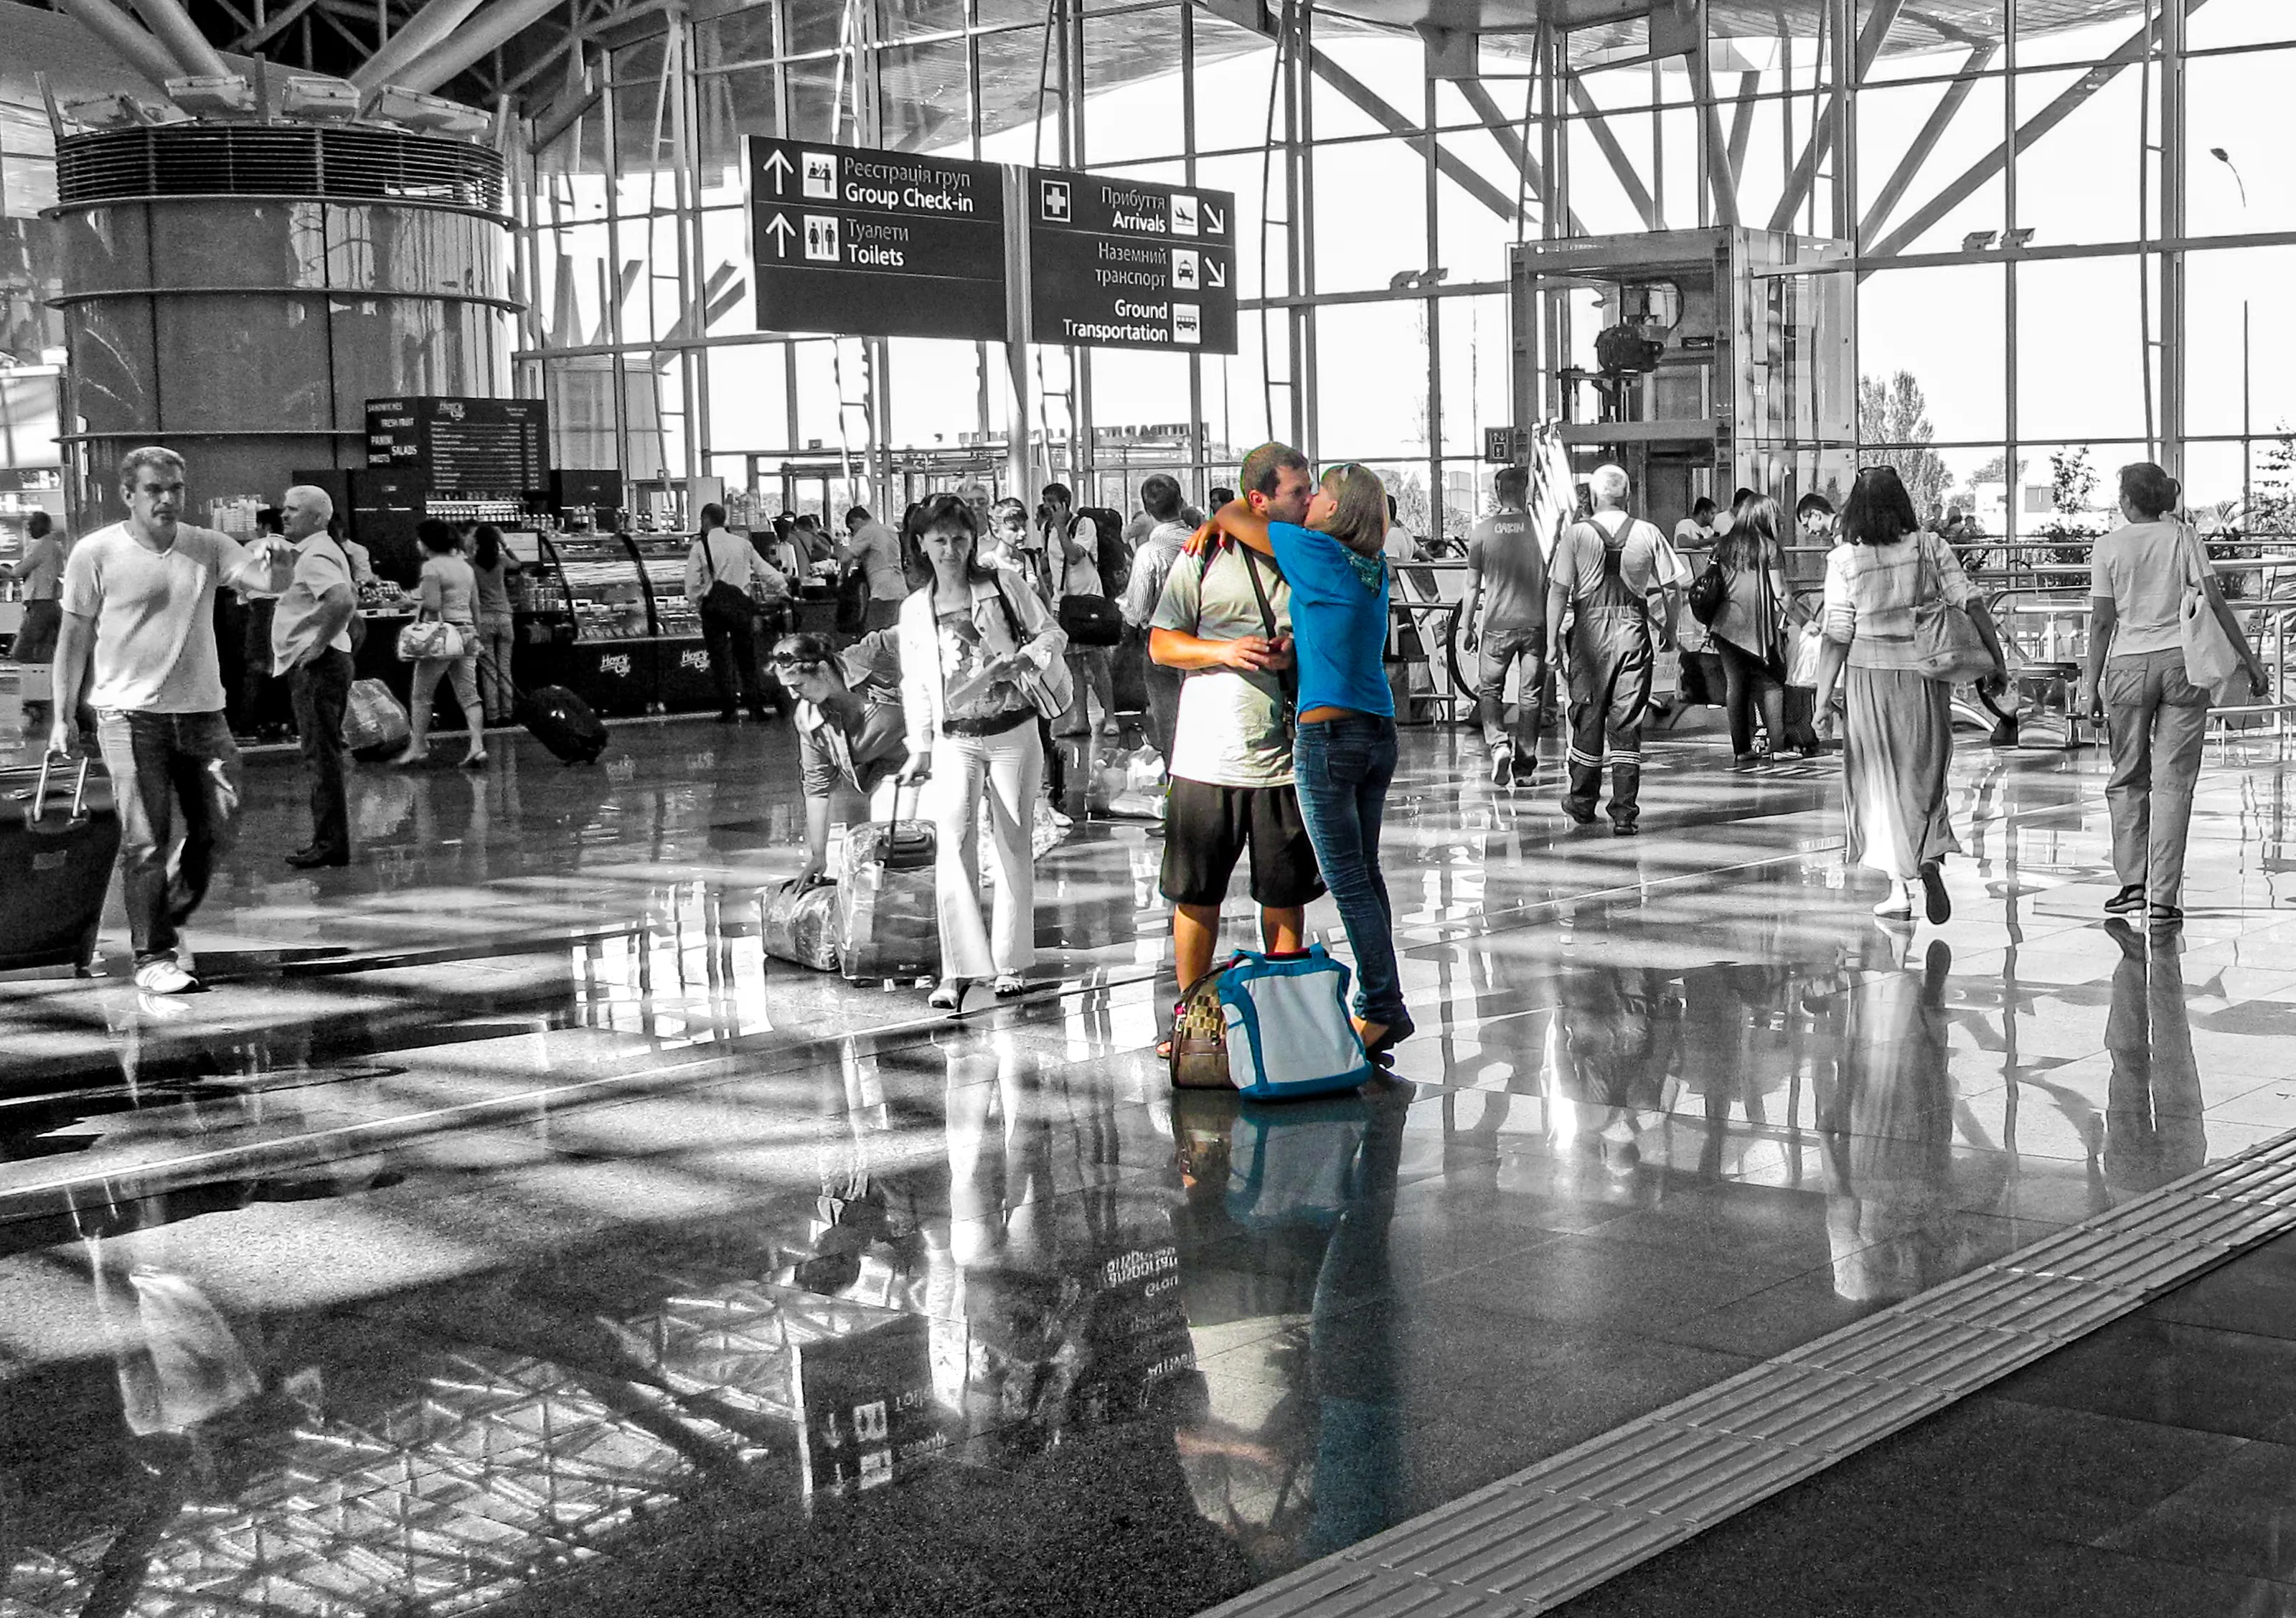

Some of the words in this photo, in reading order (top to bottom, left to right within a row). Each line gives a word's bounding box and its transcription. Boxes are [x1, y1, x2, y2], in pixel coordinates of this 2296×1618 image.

[844, 156, 931, 187] Реєстрація
[936, 170, 971, 191] груп
[845, 182, 898, 210] Group
[903, 187, 974, 212] Check-in
[1101, 186, 1166, 210] Прибуття
[847, 218, 909, 242] Туалети
[1112, 210, 1166, 233] Arrivals
[847, 244, 904, 267] Toilets
[1098, 241, 1167, 265] Наземний
[1095, 269, 1166, 291] транспорт
[1114, 298, 1168, 320] Ground
[1063, 318, 1168, 343] Transportation
[391, 445, 418, 456] SALADS
